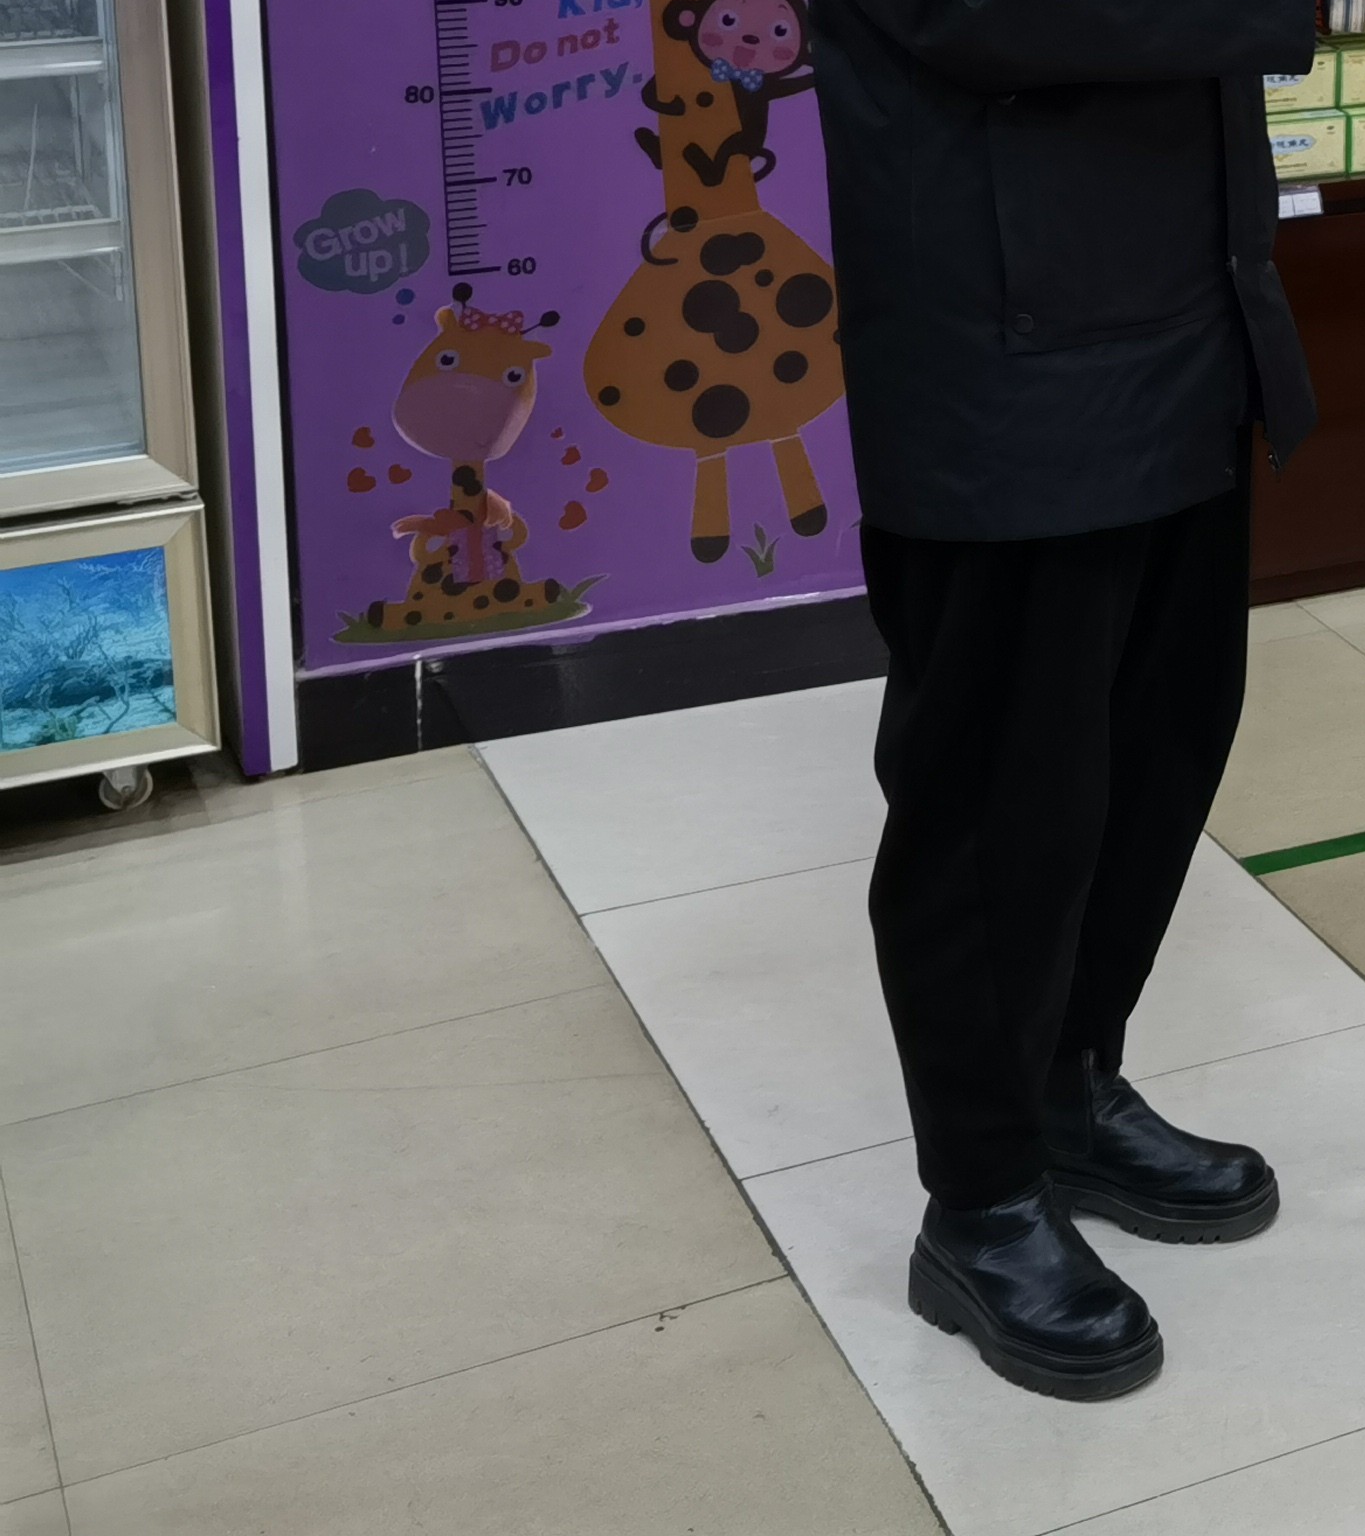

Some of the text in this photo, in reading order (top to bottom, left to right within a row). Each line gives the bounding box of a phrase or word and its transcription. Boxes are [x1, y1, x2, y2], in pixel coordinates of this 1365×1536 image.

[490, 19, 620, 72] Do not
[404, 85, 434, 104] 80
[479, 61, 642, 130] Worry.
[504, 167, 532, 186] 70
[304, 207, 407, 261] Grow
[343, 241, 409, 281] up!
[507, 258, 536, 276] 60
